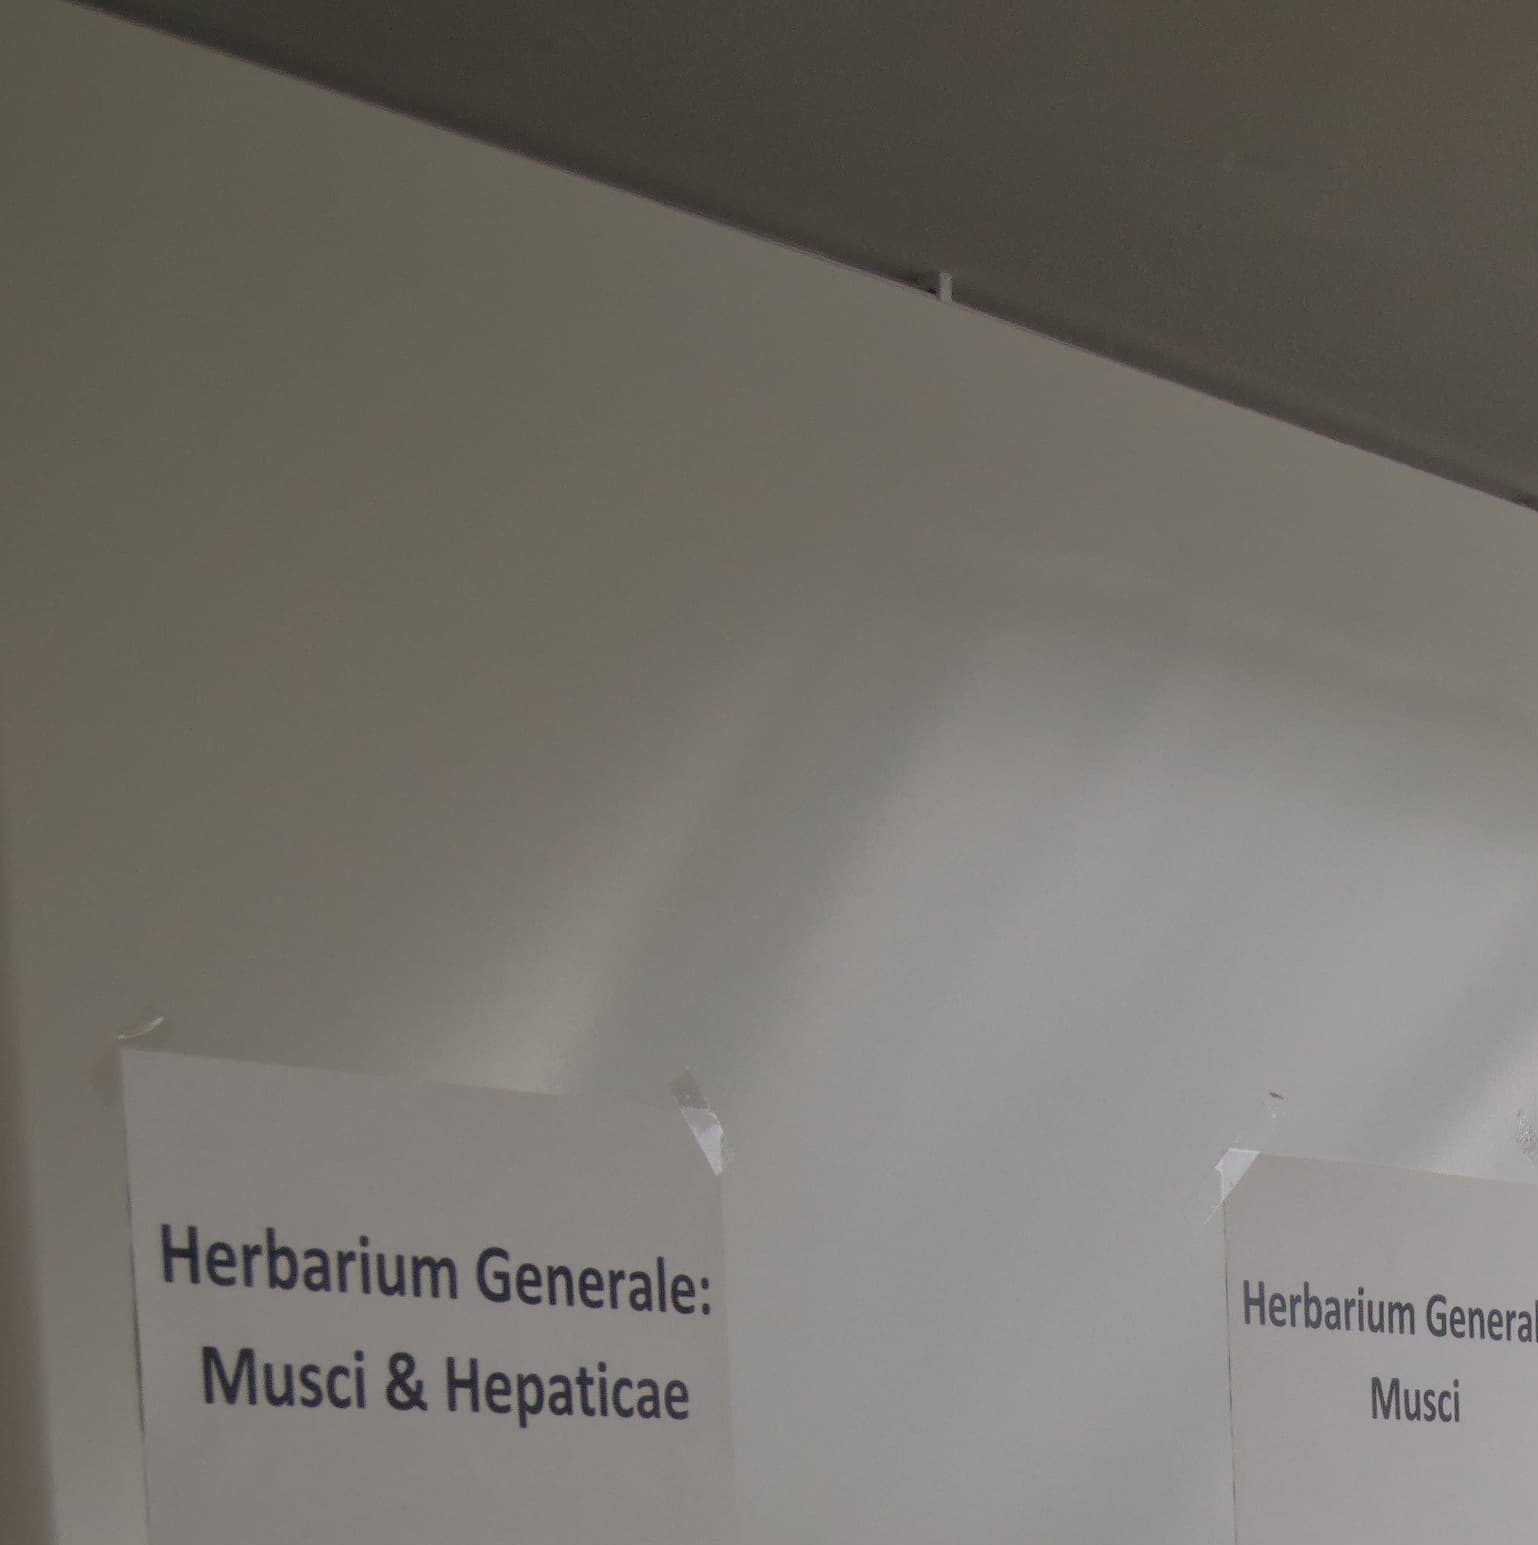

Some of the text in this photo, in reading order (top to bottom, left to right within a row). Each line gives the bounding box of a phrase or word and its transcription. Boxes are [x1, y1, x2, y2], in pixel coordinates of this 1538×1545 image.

[160, 1223, 711, 1316] Herbarium Generale:
[1243, 1279, 1416, 1335] Herbarium
[201, 1345, 690, 1428] Musci & Hepaticae
[1371, 1376, 1461, 1423] Musci
